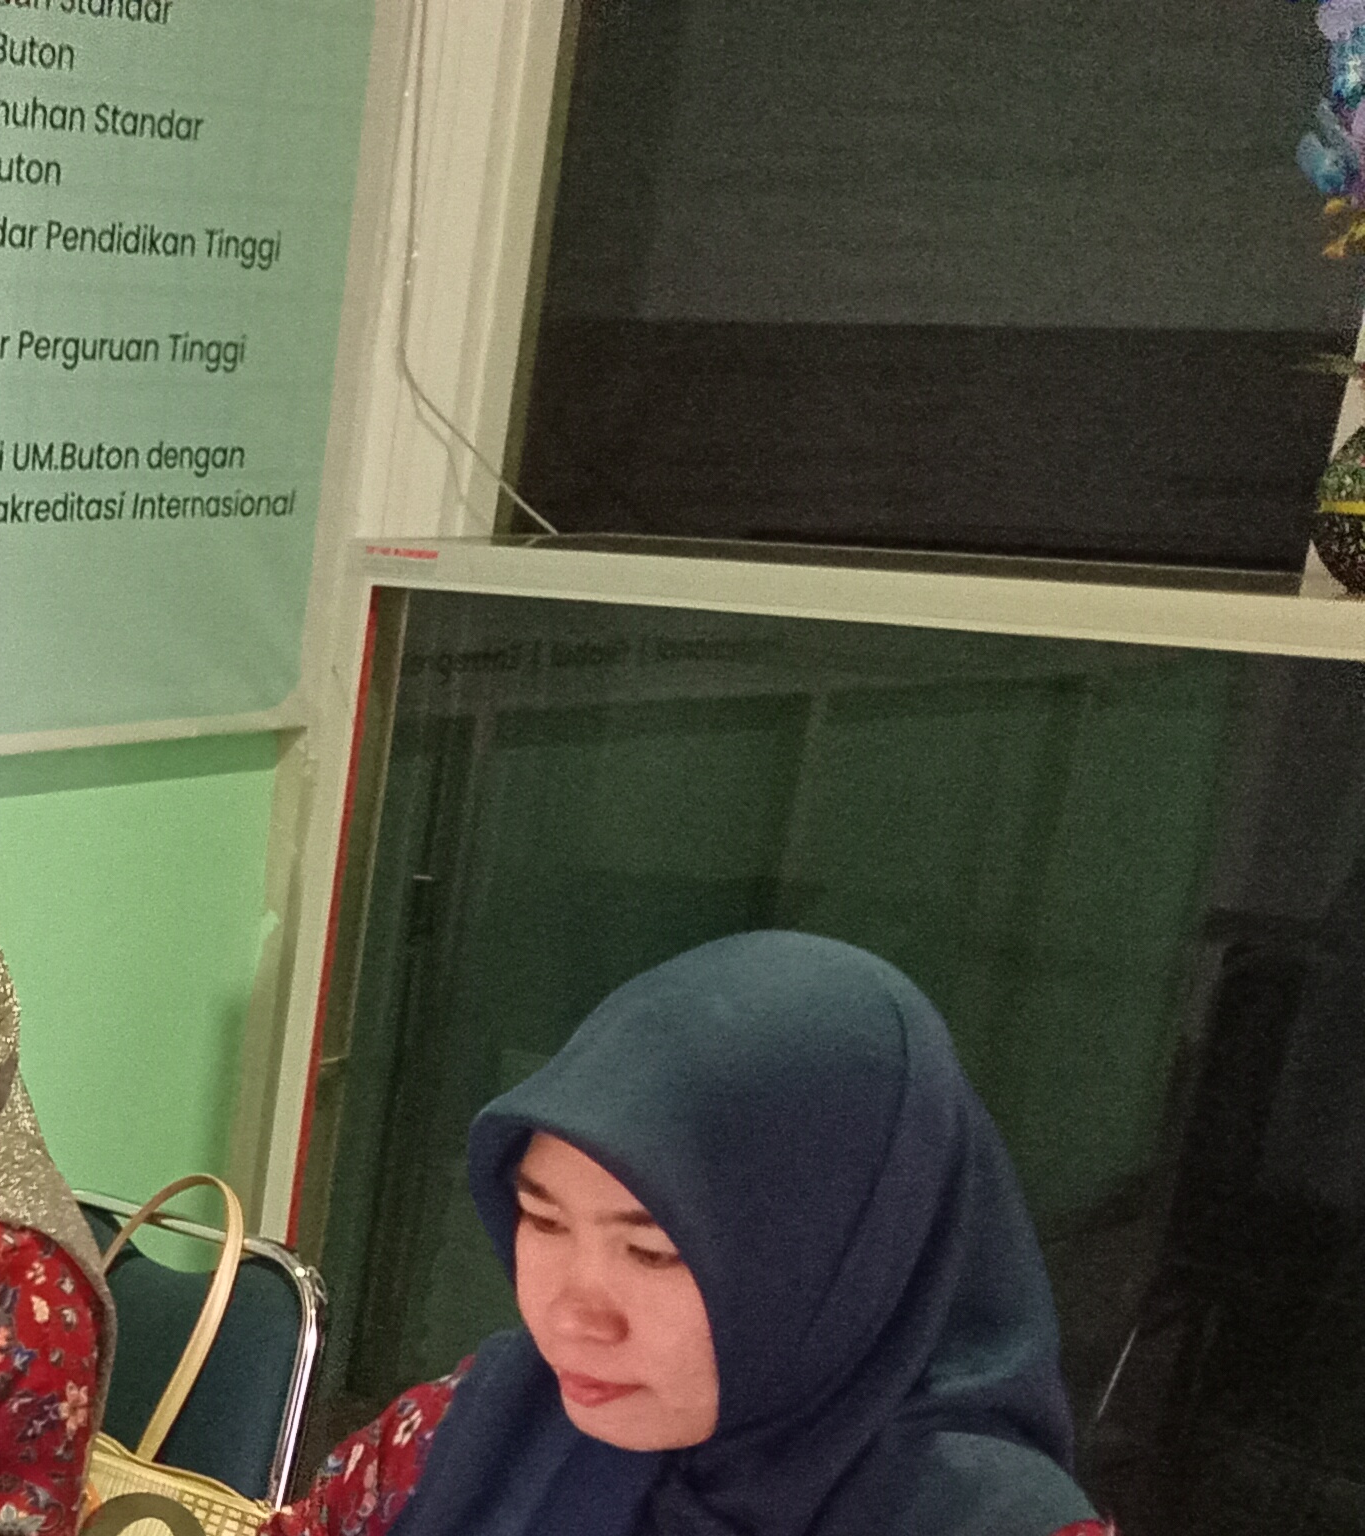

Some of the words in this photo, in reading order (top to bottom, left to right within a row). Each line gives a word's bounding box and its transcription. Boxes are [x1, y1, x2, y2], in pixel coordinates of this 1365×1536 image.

[93, 102, 204, 141] Standar
[45, 219, 196, 257] Pendidikan
[205, 228, 281, 271] Tinggi
[17, 329, 160, 371] Perguruan
[168, 333, 246, 374] Tinggi
[12, 441, 140, 472] UM.Buton
[146, 440, 246, 479] dengan
[131, 490, 296, 520] Internasional
